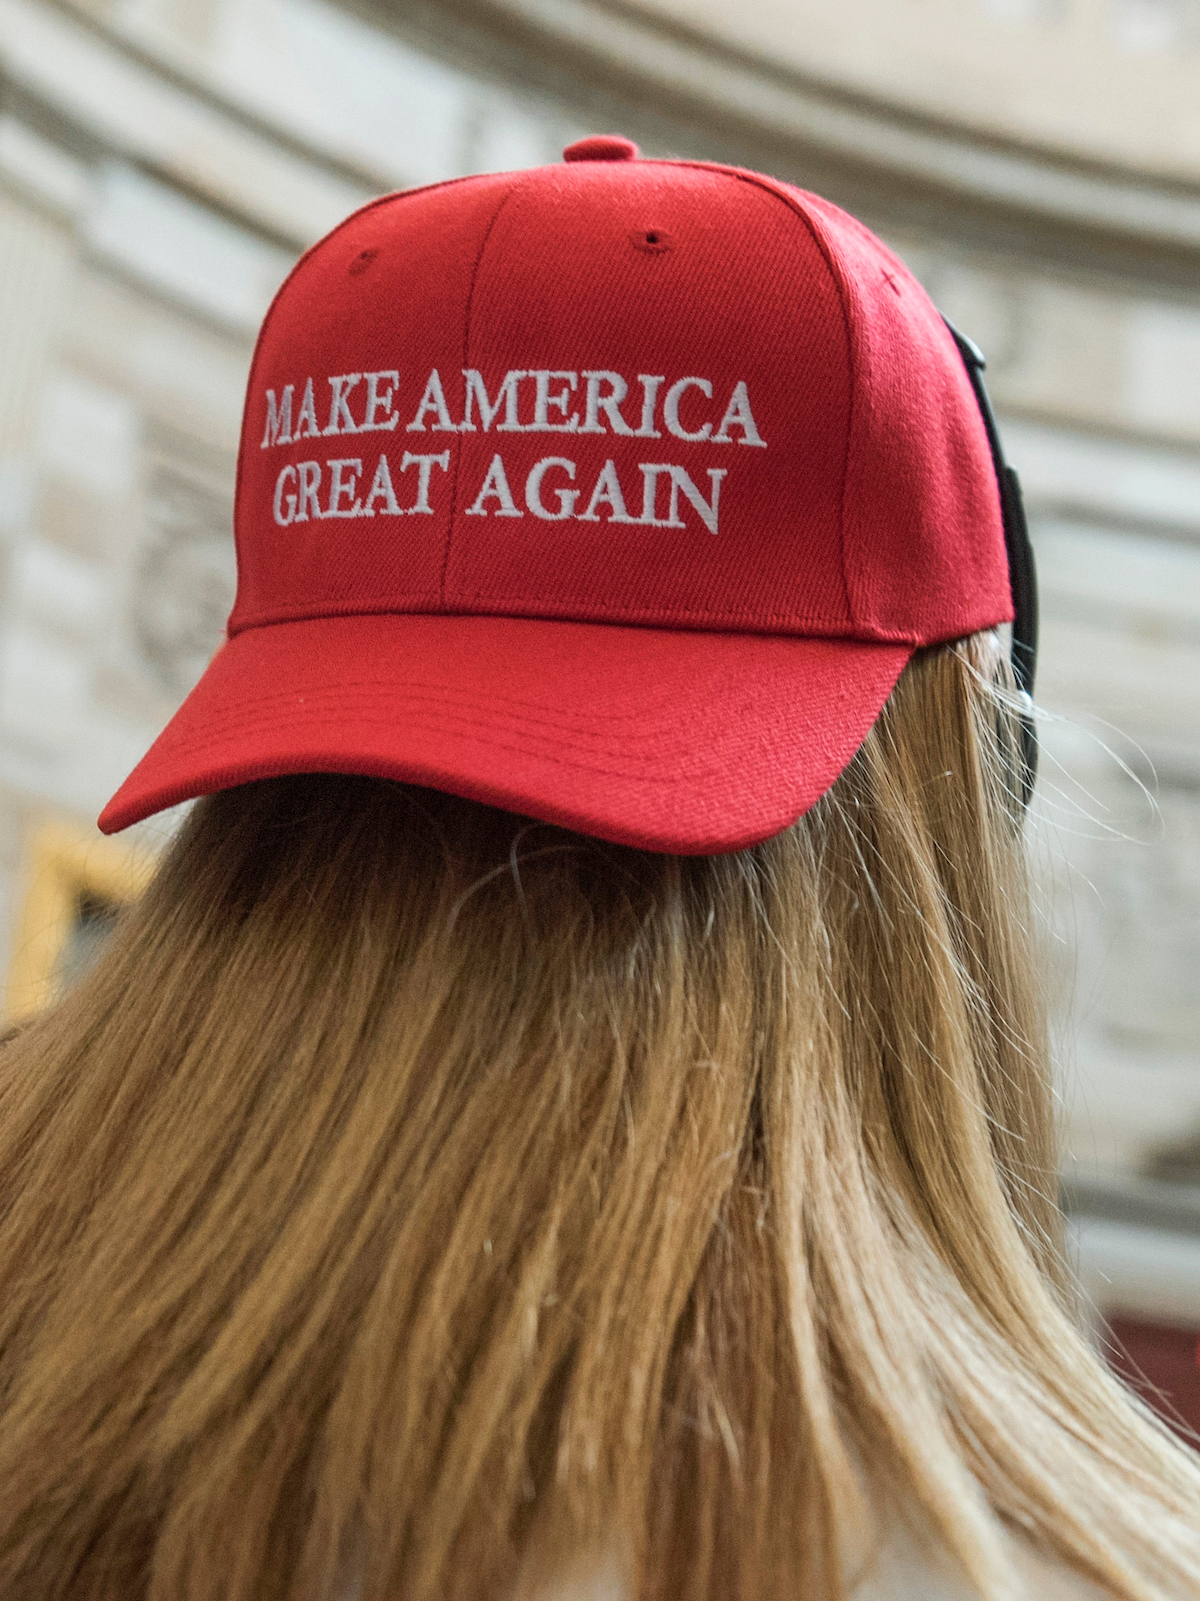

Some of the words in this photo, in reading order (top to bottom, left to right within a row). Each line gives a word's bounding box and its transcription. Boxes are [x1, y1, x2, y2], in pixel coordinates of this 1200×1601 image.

[261, 369, 400, 449] MAKE
[405, 367, 768, 448] AMERICA
[273, 449, 450, 526] GREAT
[465, 453, 728, 535] AGAIN
